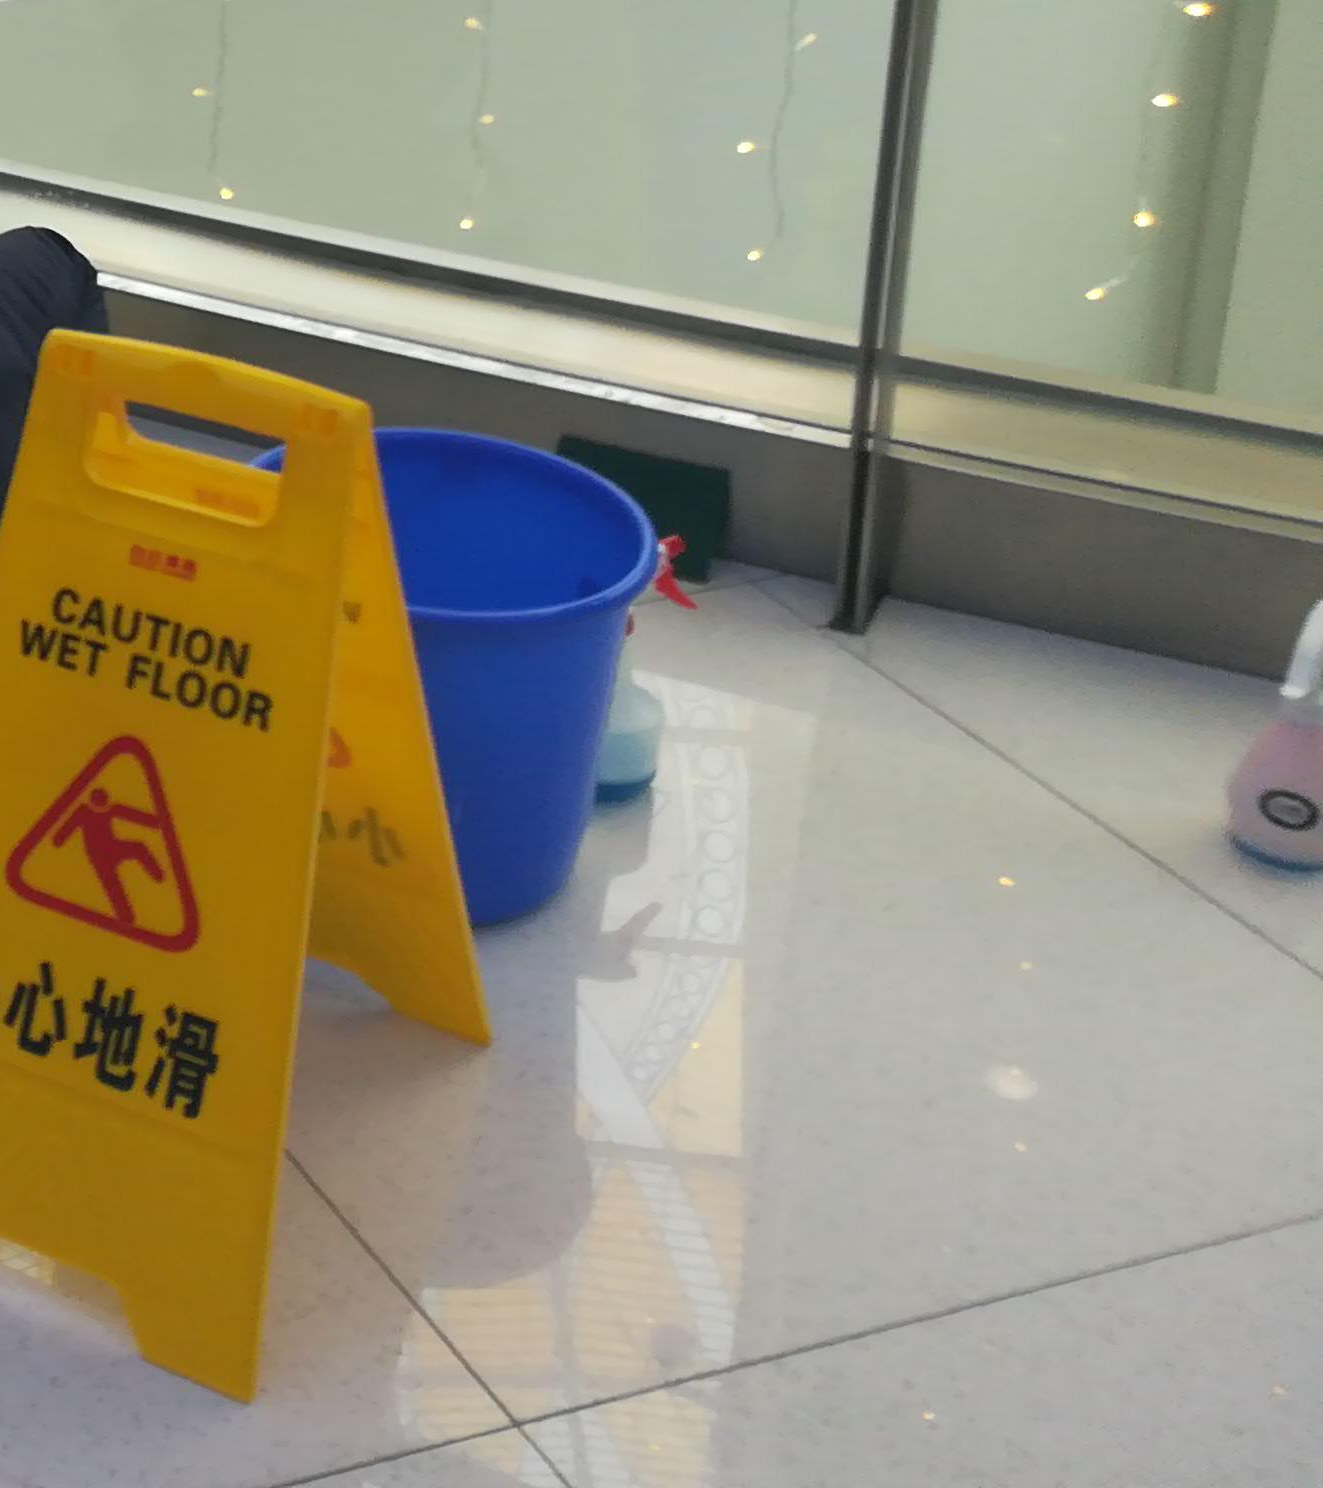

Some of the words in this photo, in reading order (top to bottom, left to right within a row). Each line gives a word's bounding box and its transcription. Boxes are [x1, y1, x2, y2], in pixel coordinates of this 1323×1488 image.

[20, 617, 109, 677] WET
[124, 653, 274, 733] FLOOR
[52, 586, 252, 680] CAUTION
